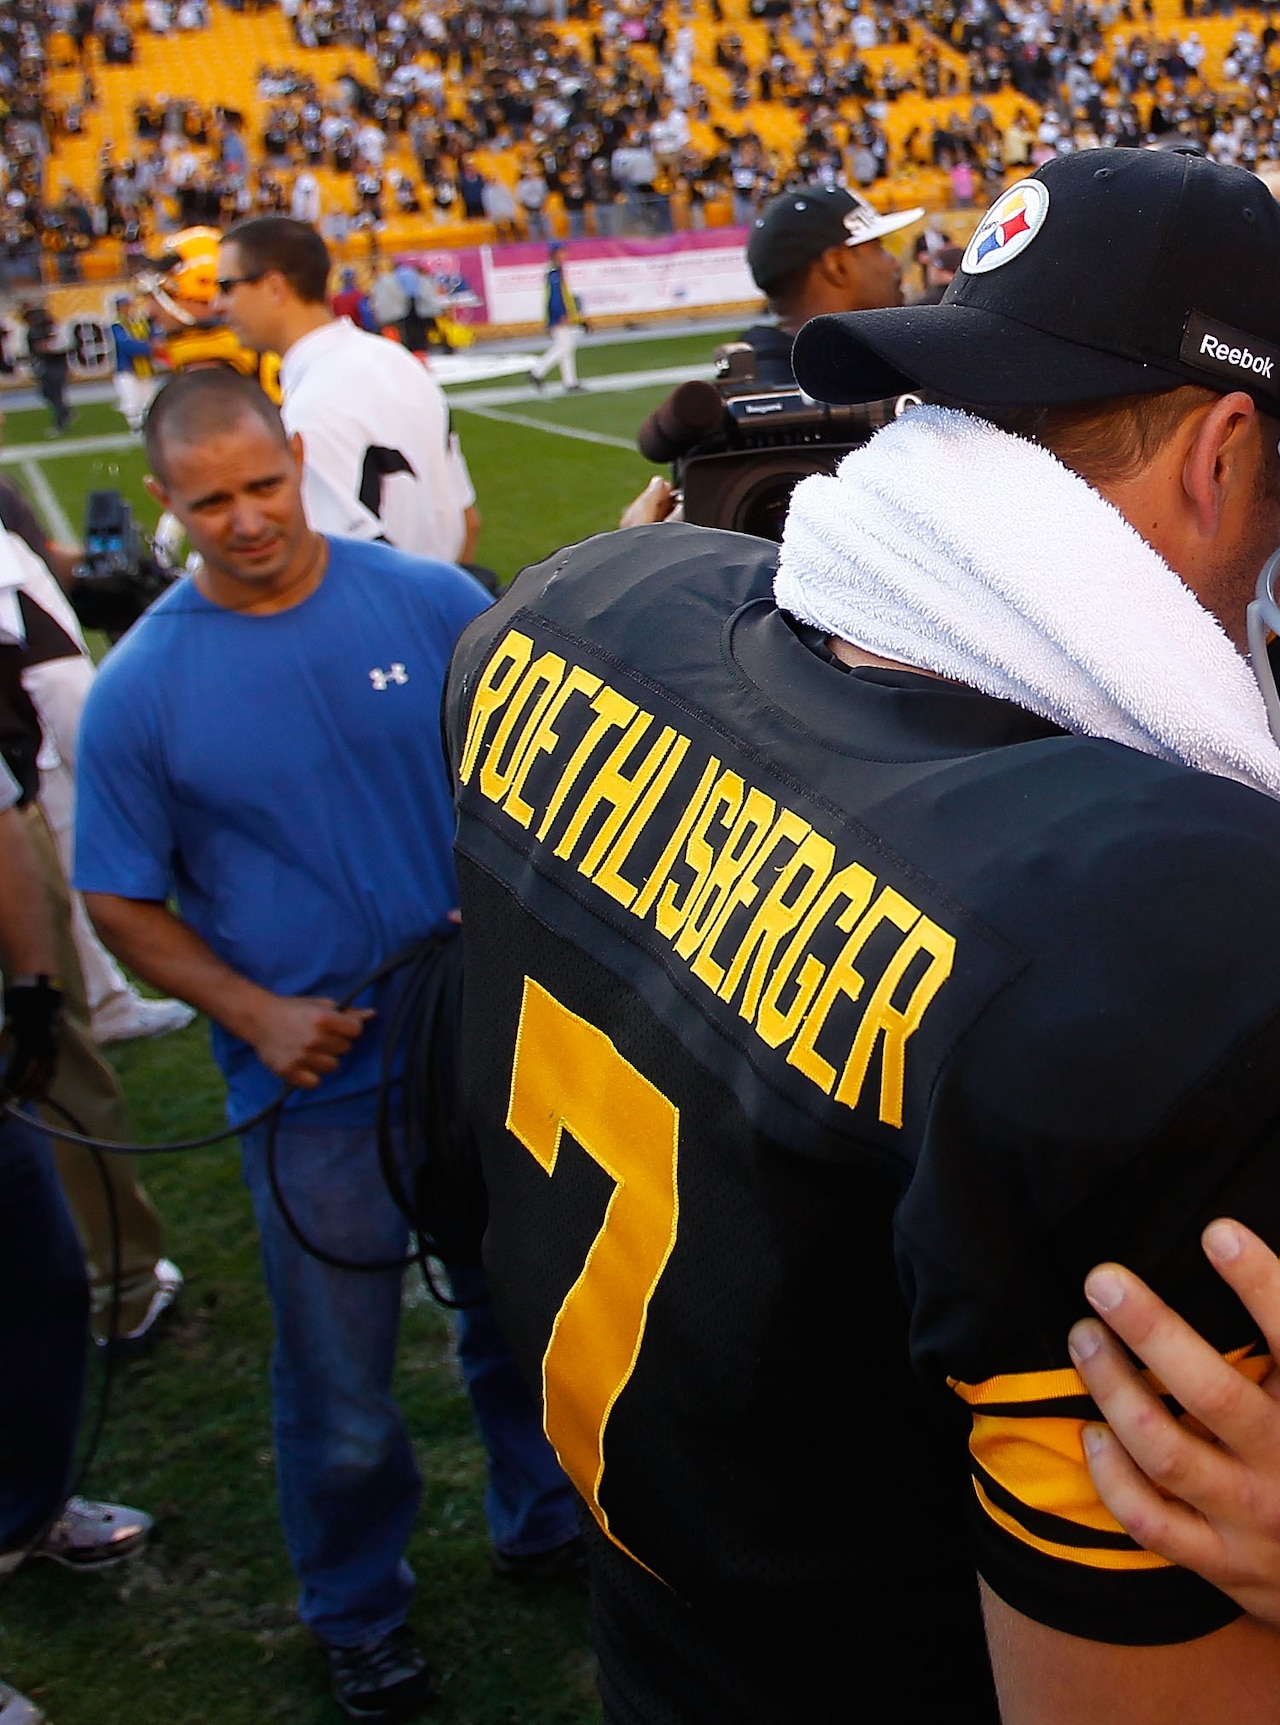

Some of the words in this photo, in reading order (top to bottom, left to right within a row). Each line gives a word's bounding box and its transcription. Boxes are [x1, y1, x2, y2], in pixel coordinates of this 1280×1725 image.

[1199, 334, 1275, 379] Reebok
[458, 629, 956, 1130] ROETHLISBERGER
[505, 974, 680, 1592] 7
